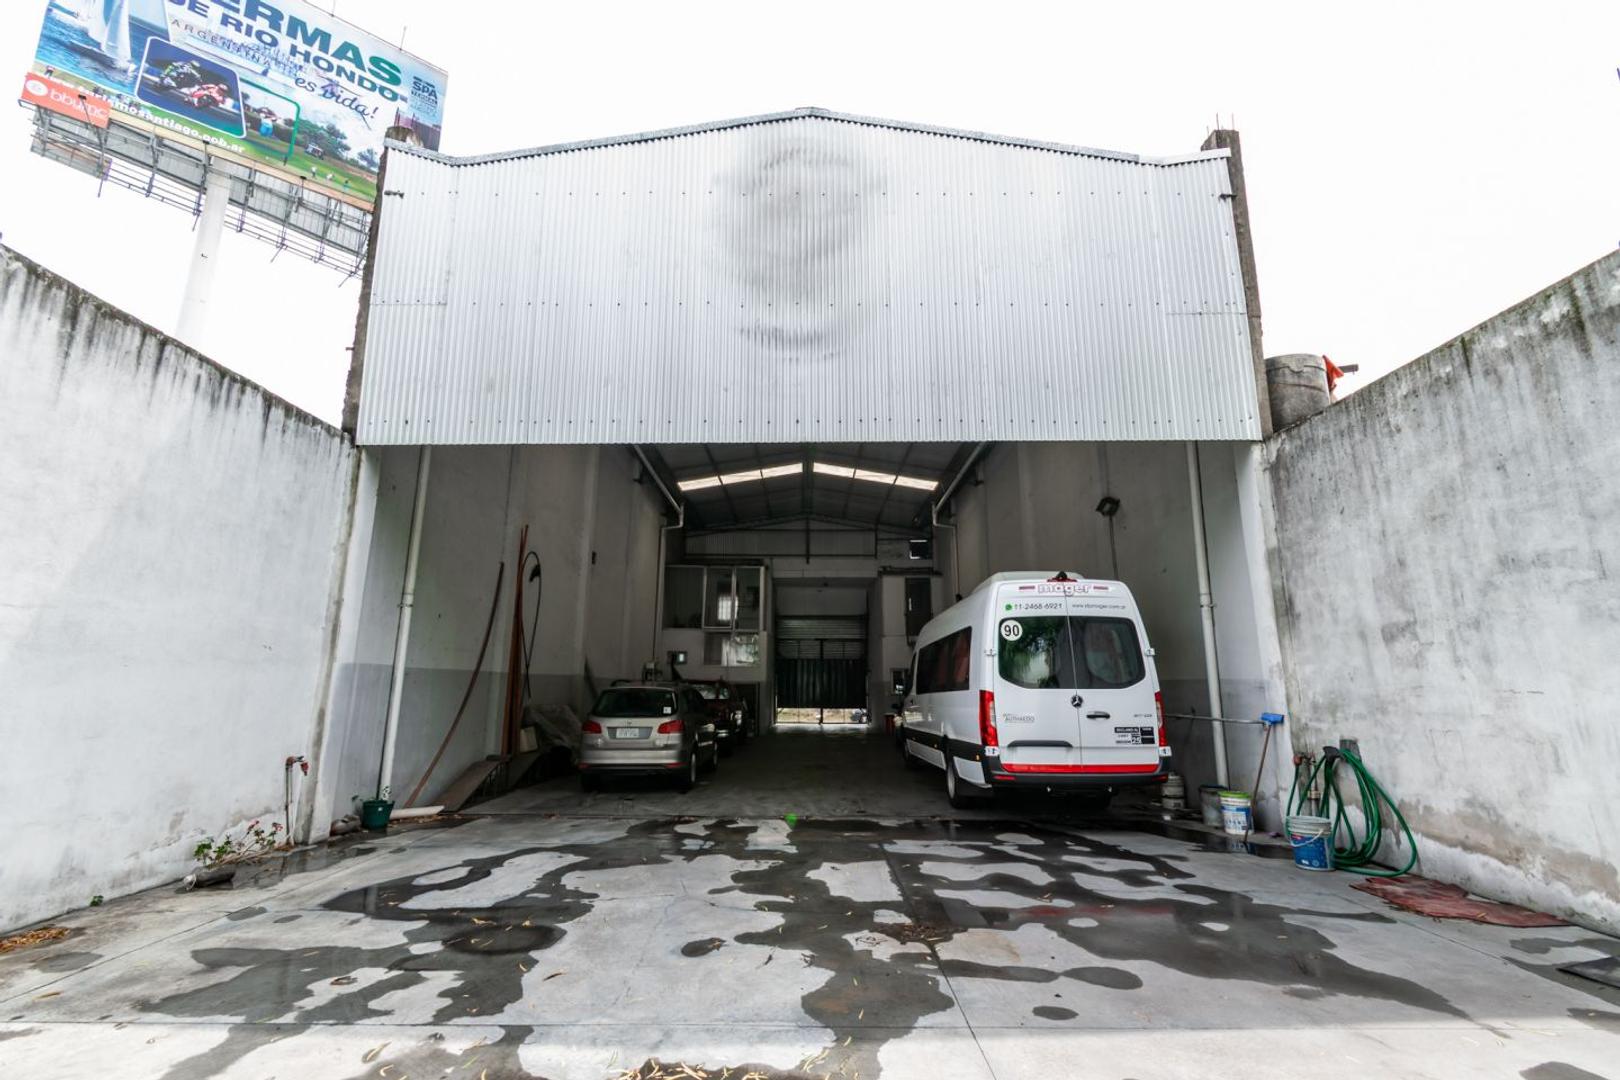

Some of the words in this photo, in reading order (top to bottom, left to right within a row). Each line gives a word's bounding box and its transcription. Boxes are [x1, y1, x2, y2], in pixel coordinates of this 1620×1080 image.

[220, 12, 279, 48] RIO
[289, 43, 399, 103] HONDO
[294, 77, 318, 93] es
[1003, 624, 1020, 637] 90
